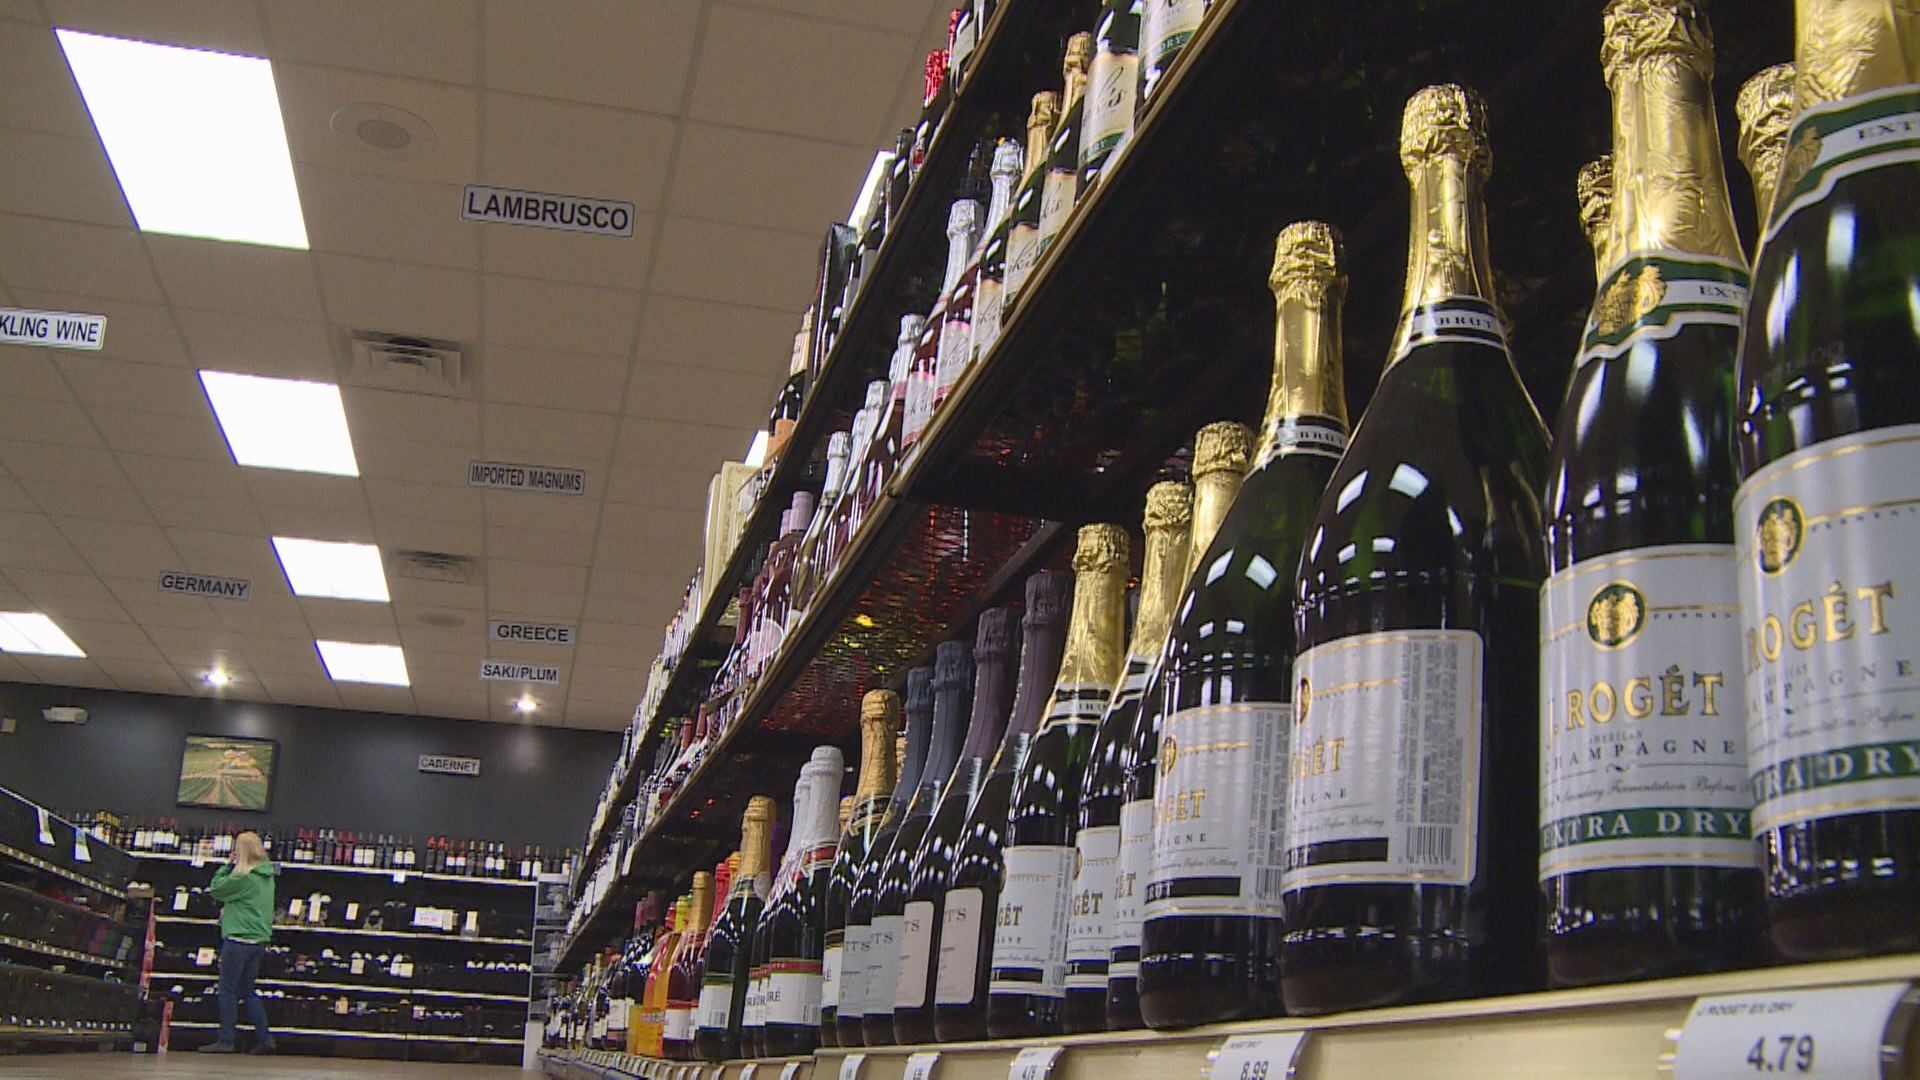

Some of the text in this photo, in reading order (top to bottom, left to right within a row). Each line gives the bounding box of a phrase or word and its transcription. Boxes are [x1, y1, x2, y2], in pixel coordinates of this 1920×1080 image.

[468, 191, 628, 231] LAMBRUSCO
[57, 319, 98, 342] WINE
[471, 464, 581, 490] IMPORTED MAGNUMS
[162, 575, 247, 596] GERMANY
[497, 624, 568, 642] GREECE
[483, 663, 557, 680] SAKI/PLUM
[1567, 664, 1723, 731] ROGÉT
[1829, 746, 1920, 780] DRY
[1543, 811, 1745, 849] EXTRA DRY
[1746, 1033, 1814, 1072] 4.79
[1240, 1060, 1269, 1080] 8.99
